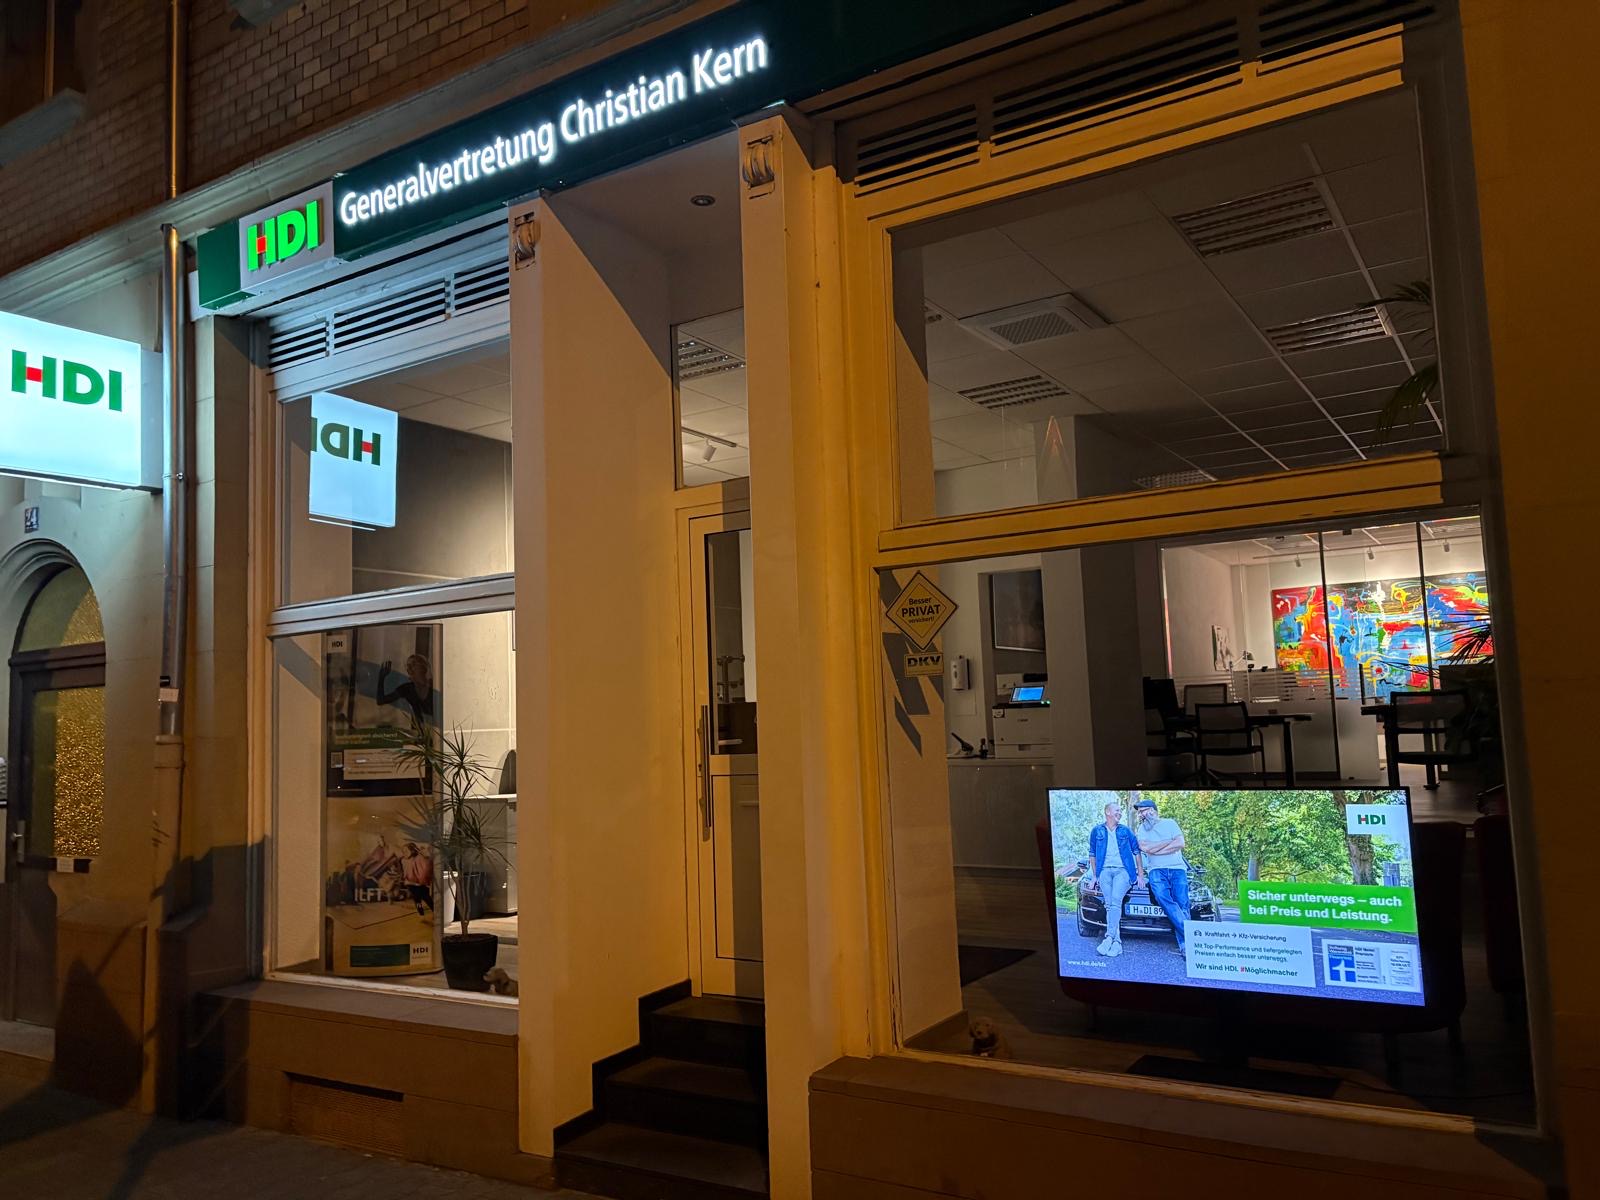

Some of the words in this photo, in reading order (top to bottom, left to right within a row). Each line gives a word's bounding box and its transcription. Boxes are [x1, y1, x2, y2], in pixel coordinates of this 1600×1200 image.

[339, 121, 556, 226] Generalvertretung
[560, 75, 687, 143] Christian
[692, 36, 768, 94] Kern
[247, 199, 319, 272] HDI
[11, 349, 122, 412] HDI
[908, 597, 932, 605] Besser
[901, 604, 941, 618] PRIVAT
[907, 655, 941, 667] DKV
[1357, 814, 1386, 825] HDI
[1247, 889, 1287, 902] Sicher
[1289, 892, 1355, 907] unterwegs
[1369, 895, 1403, 907] auch
[1248, 904, 1267, 916] bei
[1270, 905, 1302, 917] Preis
[1305, 907, 1329, 919] und
[1332, 908, 1393, 924] Leistung.
[1238, 932, 1287, 942] Kfz-Versicherung
[1195, 962, 1207, 970] Wir
[1208, 963, 1223, 971] sind
[1240, 966, 1298, 977] #Möglichmacher
